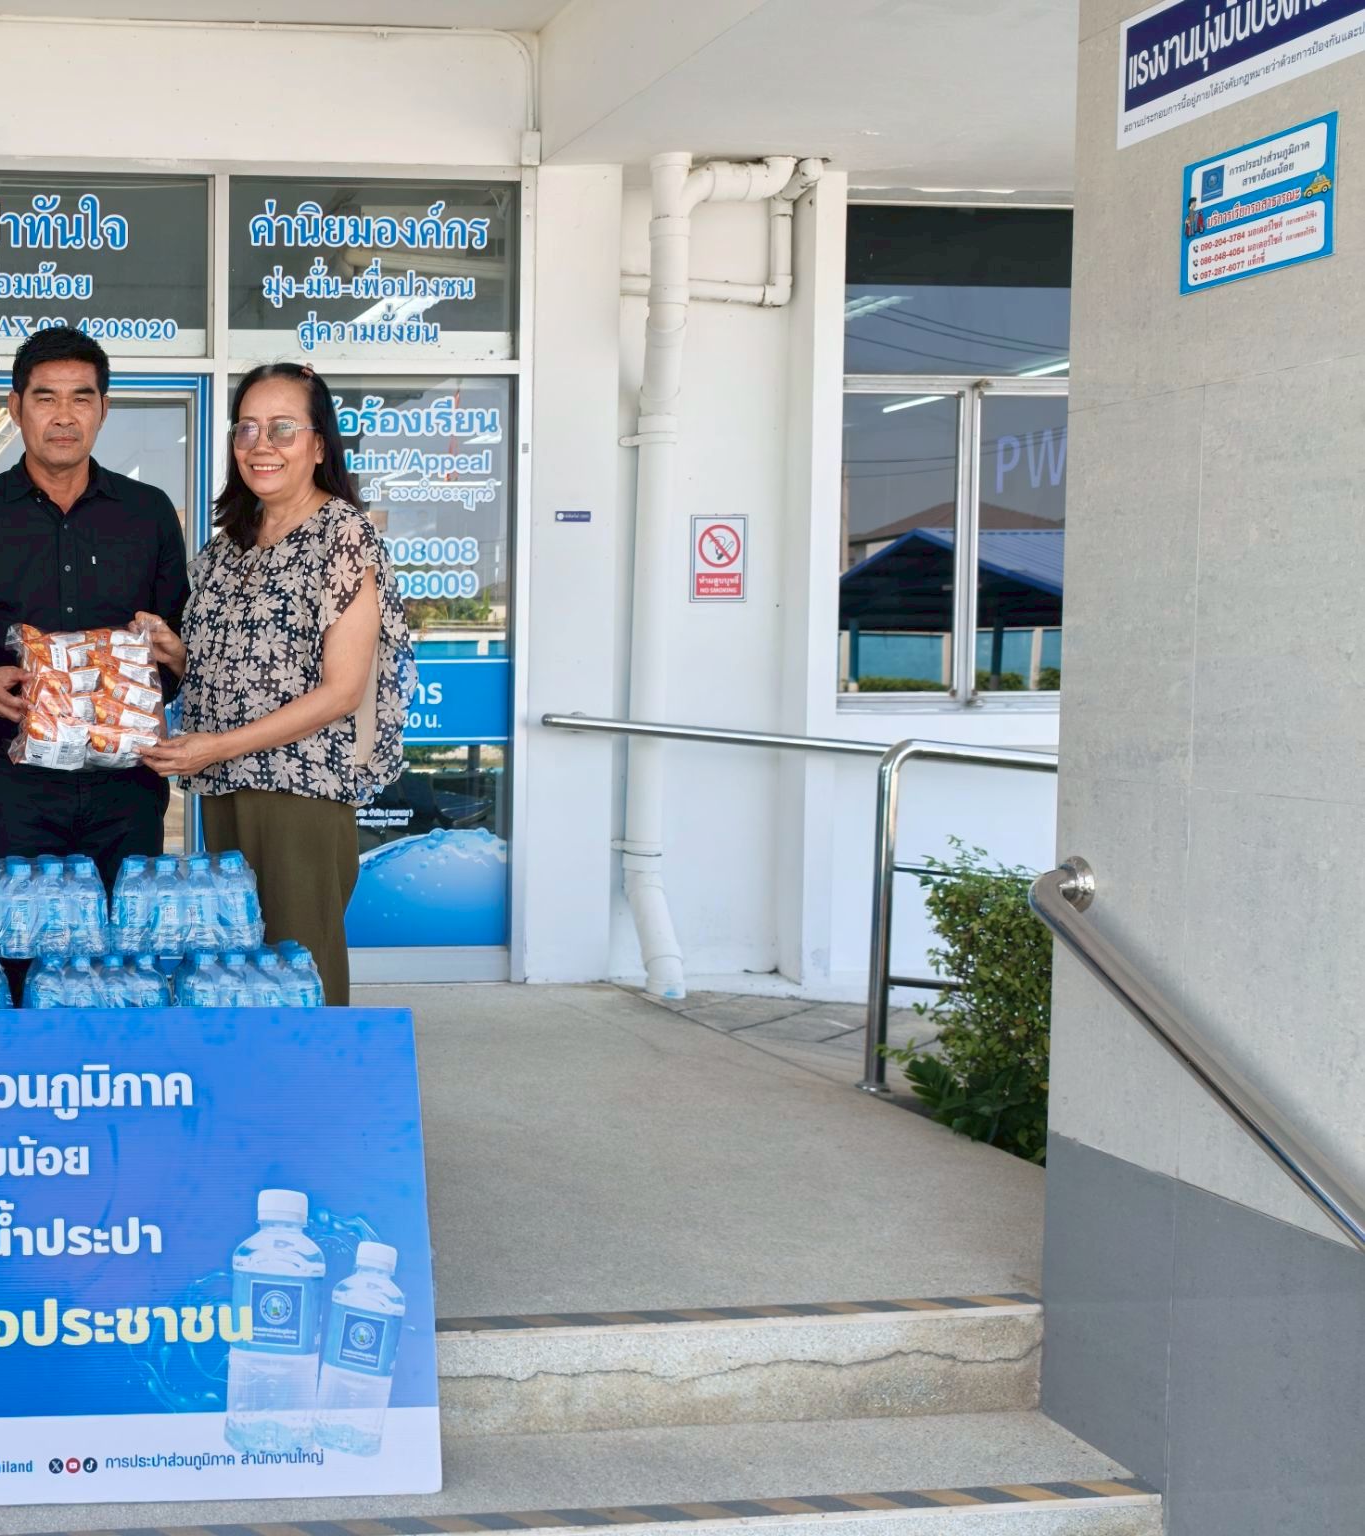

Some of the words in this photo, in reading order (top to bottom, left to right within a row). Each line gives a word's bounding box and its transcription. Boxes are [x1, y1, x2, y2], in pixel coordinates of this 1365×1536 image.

[1229, 140, 1310, 176] การประปาส่วนภูมิภาค
[1242, 162, 1295, 186] สาขาอ้อมน้อย
[250, 199, 488, 248] ค่านิยมองค์กร
[263, 258, 475, 307] มุ่ง-มั่น-เพื่อปวงชน
[298, 304, 438, 350] สู่ความยั่งยืน
[105, 1452, 235, 1471] การประปาส่วนภูมิภาค
[240, 1447, 325, 1466] สำนักงานใหญ่
